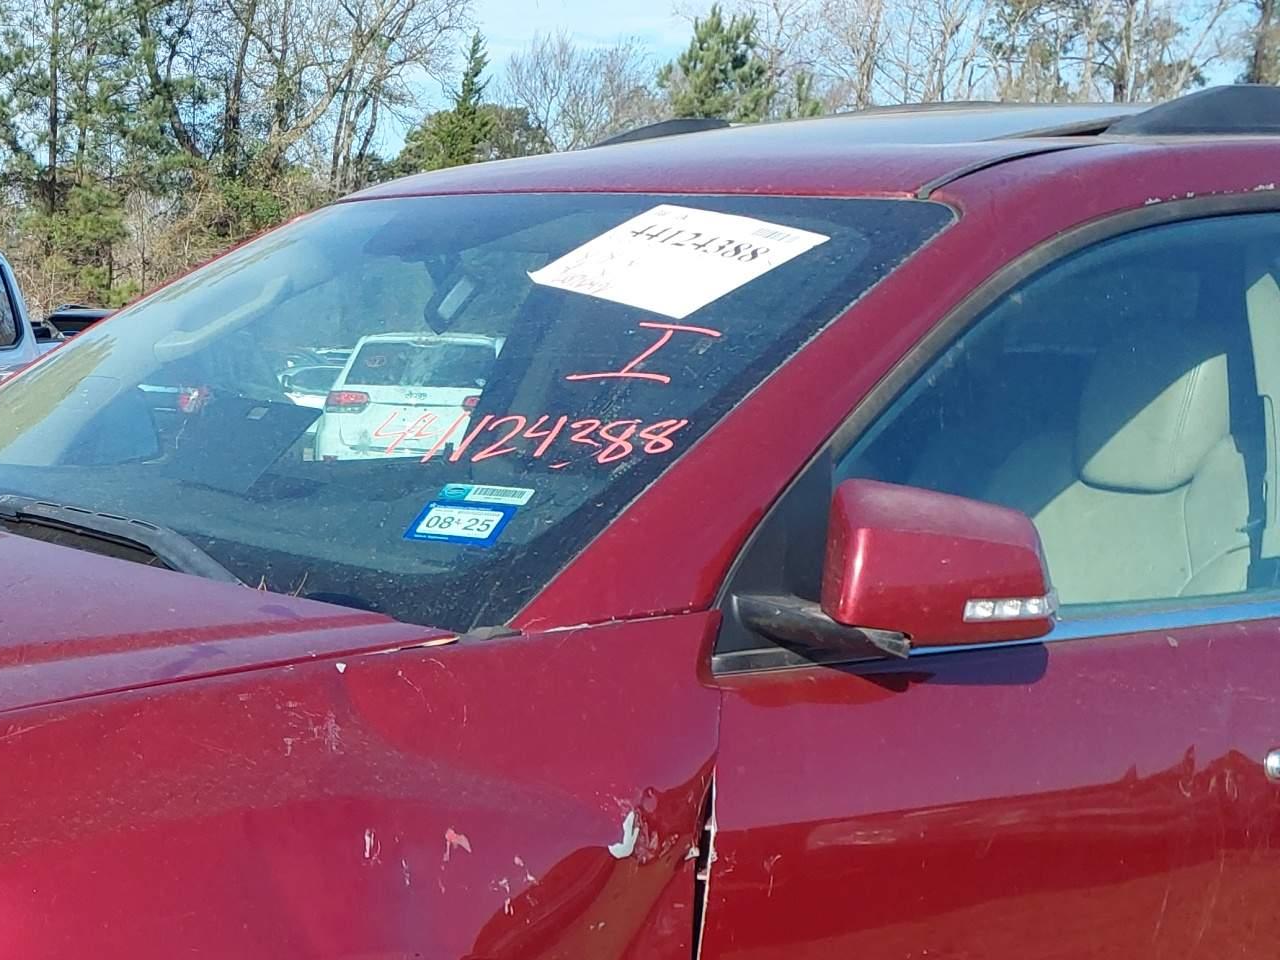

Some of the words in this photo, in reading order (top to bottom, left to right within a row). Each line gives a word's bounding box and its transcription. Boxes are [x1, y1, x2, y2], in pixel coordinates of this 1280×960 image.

[630, 224, 770, 263] 44124388
[565, 321, 723, 384] I
[426, 515, 454, 529] 08
[462, 518, 494, 533] 25
